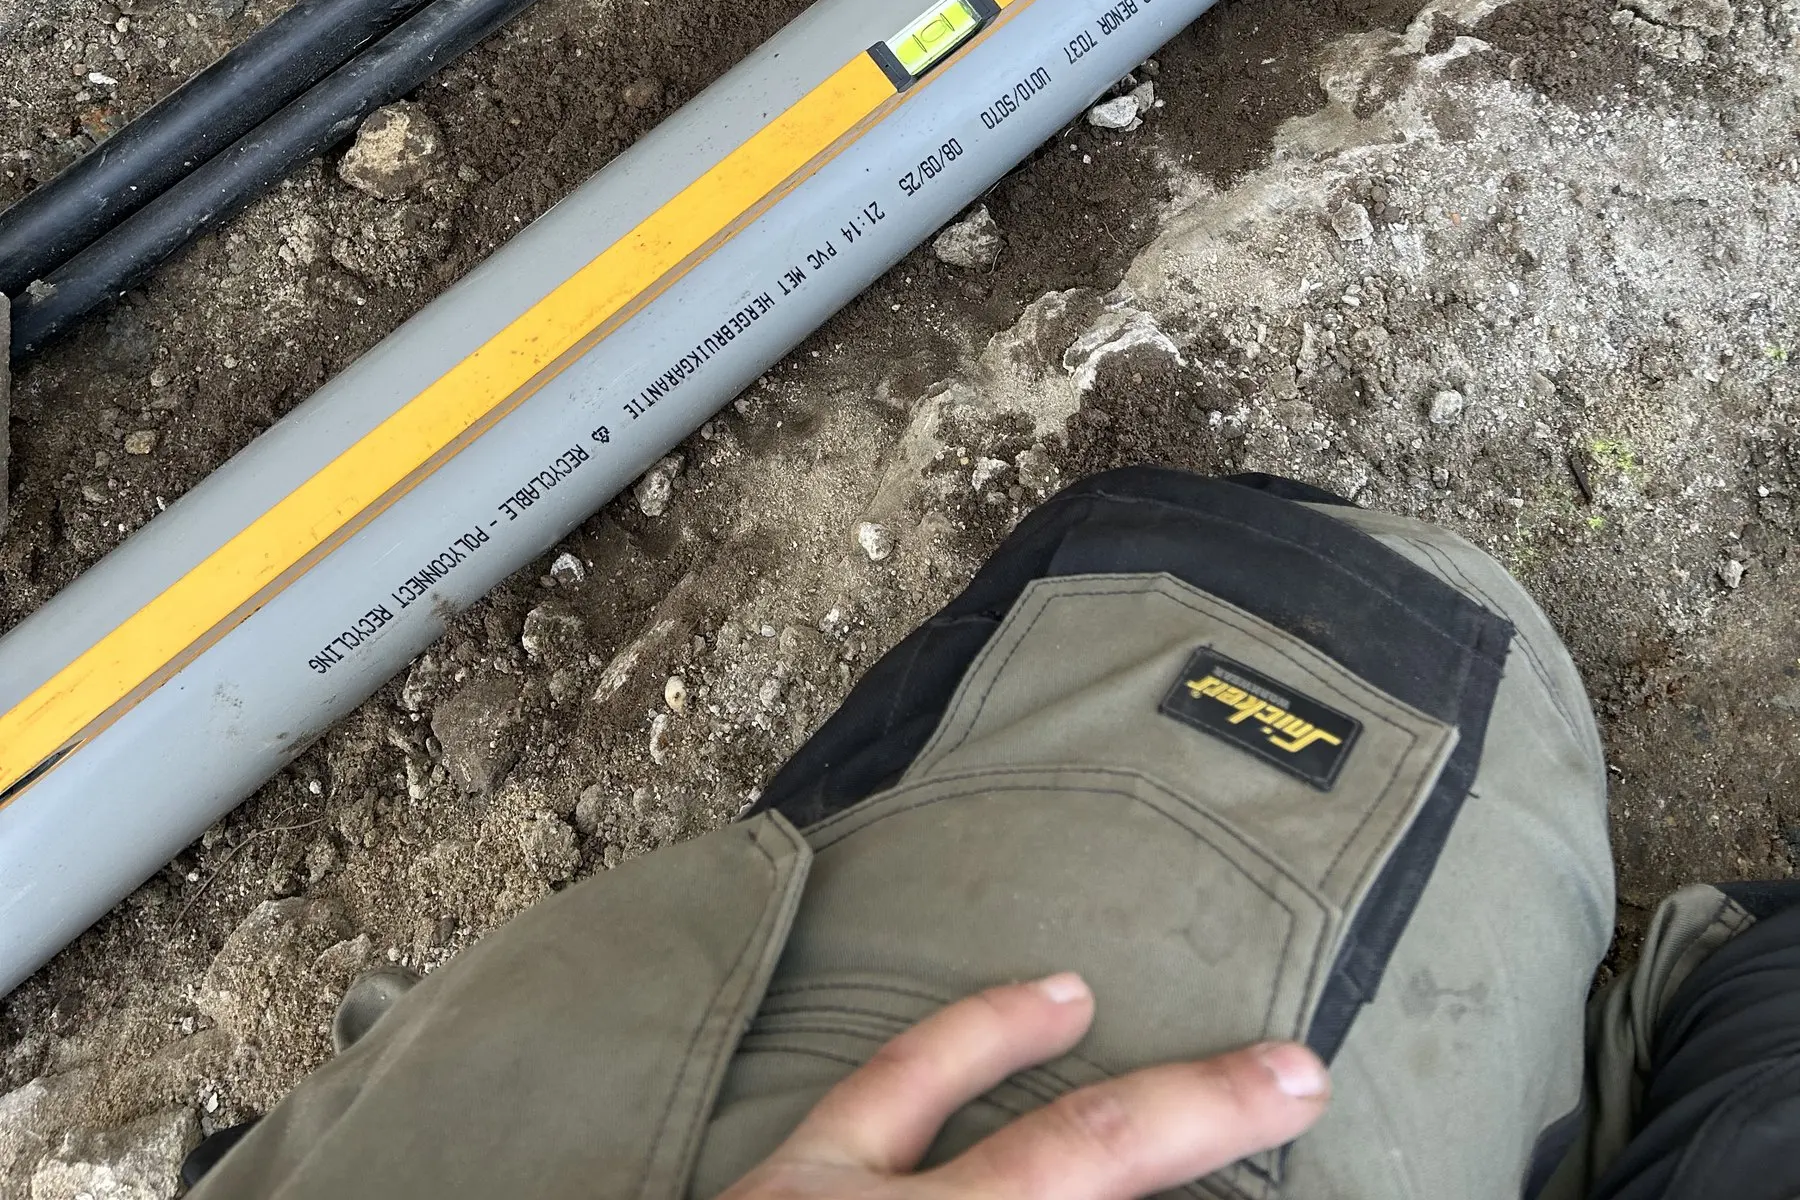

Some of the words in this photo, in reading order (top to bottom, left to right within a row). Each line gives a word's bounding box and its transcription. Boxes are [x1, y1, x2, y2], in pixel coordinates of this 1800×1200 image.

[1064, 30, 1098, 65] 7037
[899, 138, 963, 197] 08/09/25
[841, 201, 885, 243] 21:14
[777, 266, 806, 296] MET
[807, 241, 837, 270] PVC
[623, 292, 775, 420] HERGEBRUIKGARANTIE
[498, 444, 590, 521] RECYCLABLE
[392, 525, 490, 609] POLYCONNECT
[308, 604, 394, 674] RECYCLING
[1185, 675, 1342, 752] Snickers
